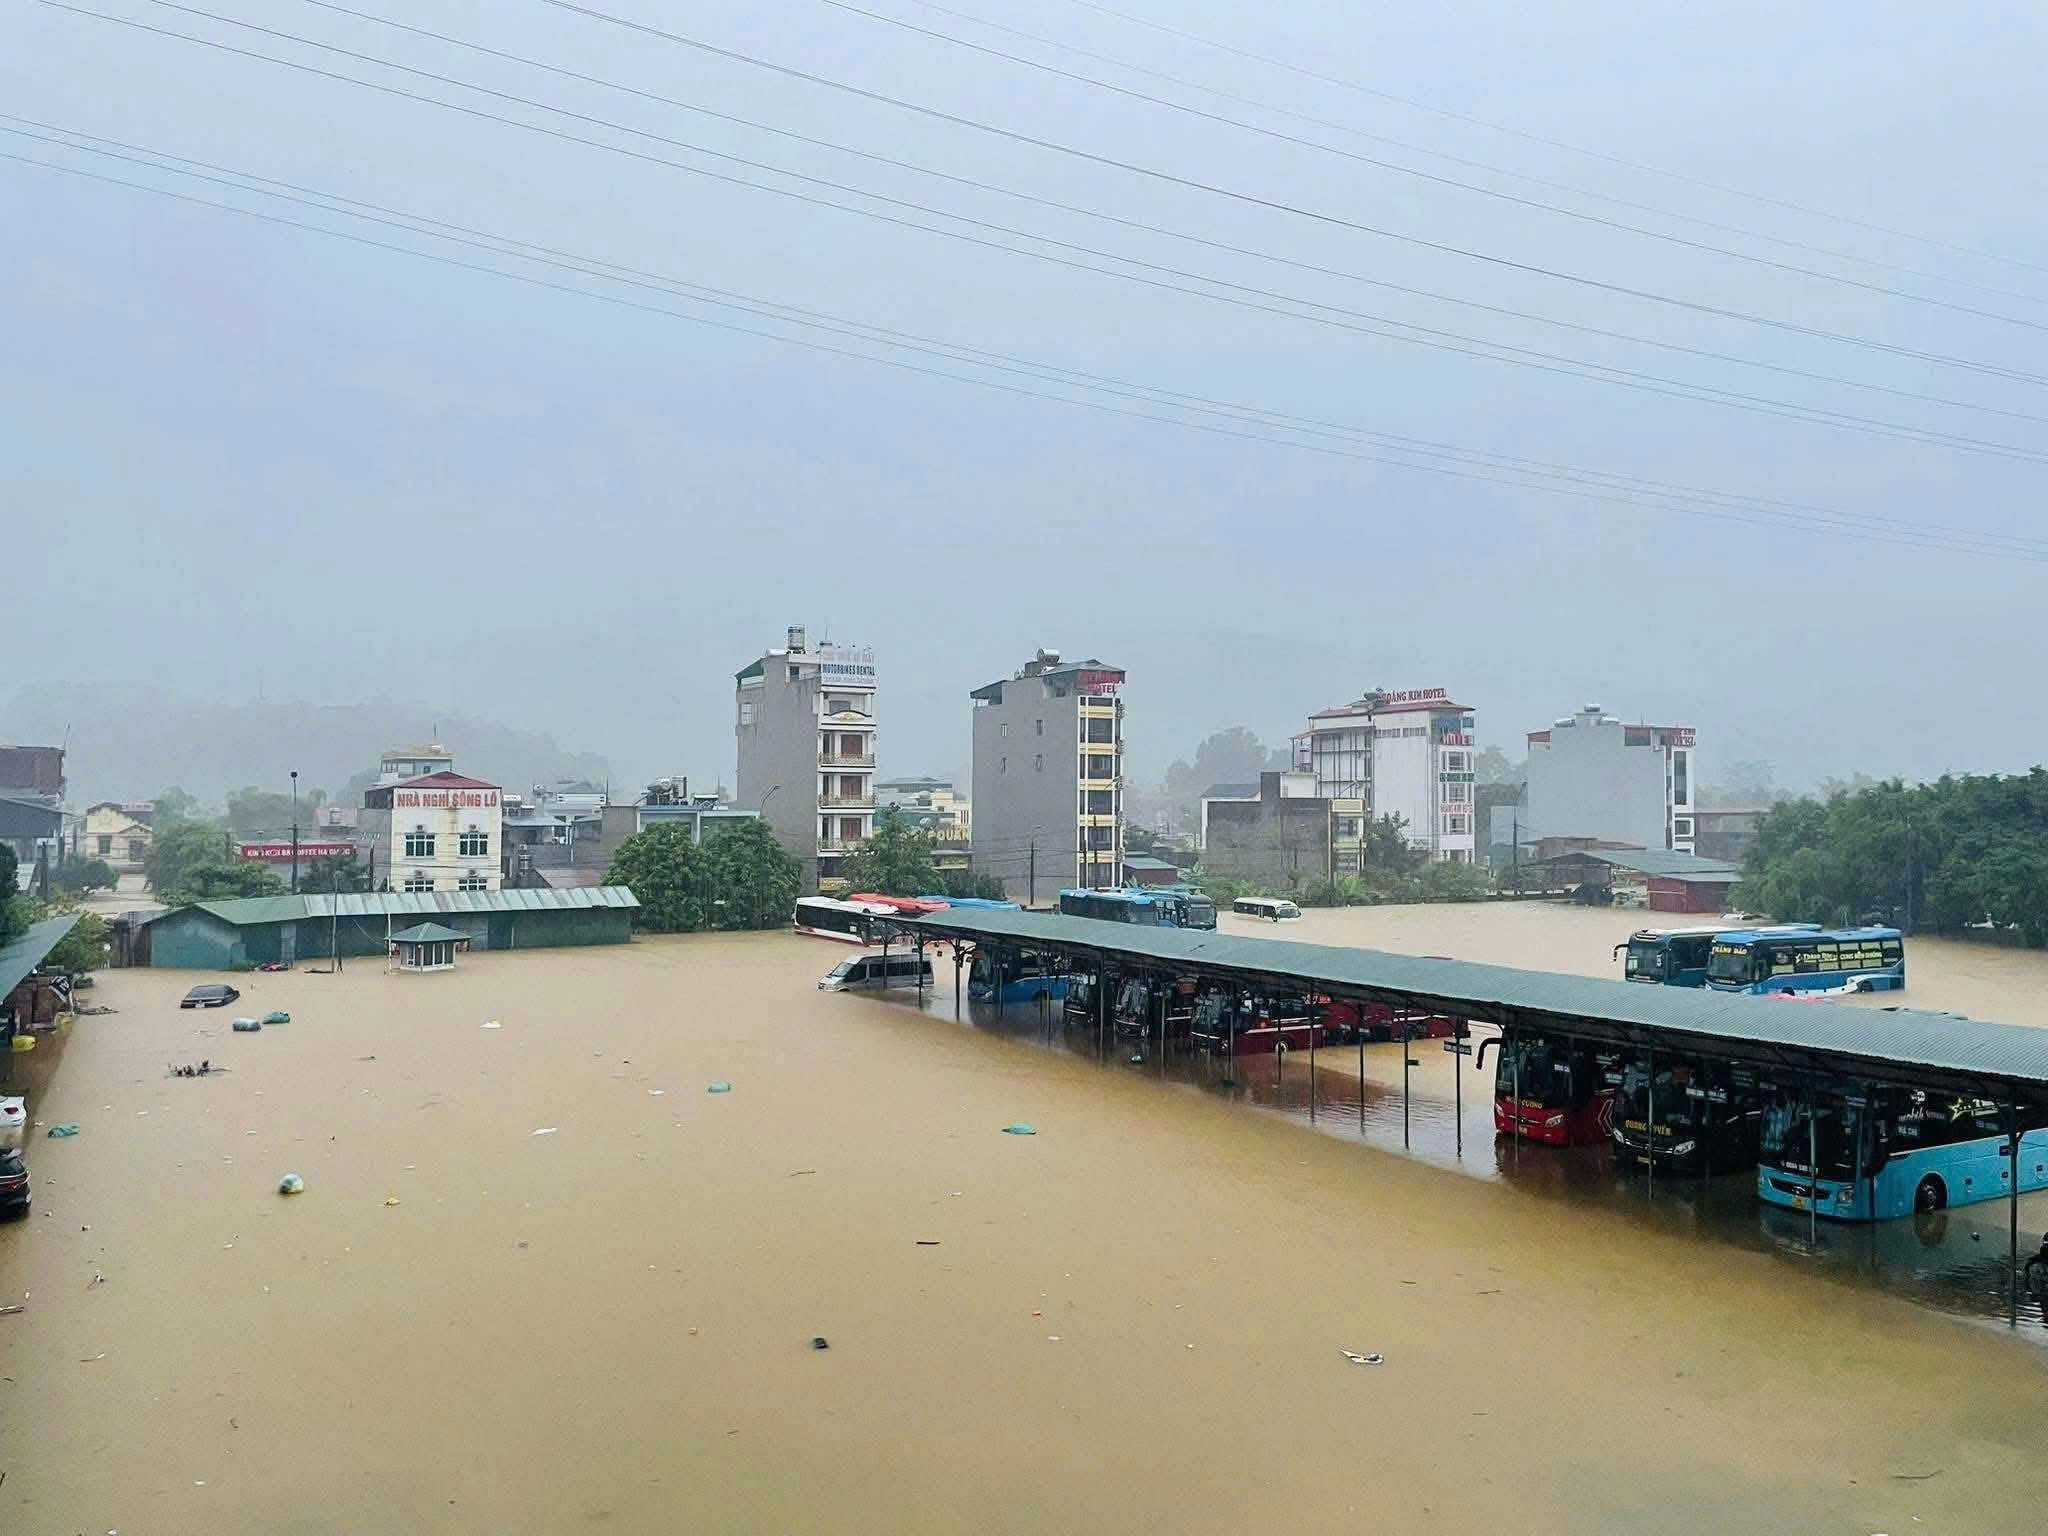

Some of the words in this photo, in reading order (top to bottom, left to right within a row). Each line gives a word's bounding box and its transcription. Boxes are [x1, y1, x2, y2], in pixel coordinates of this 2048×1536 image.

[1423, 688, 1446, 700] HOTEL
[397, 790, 420, 807] NHÀ
[452, 790, 481, 807] SÔNG
